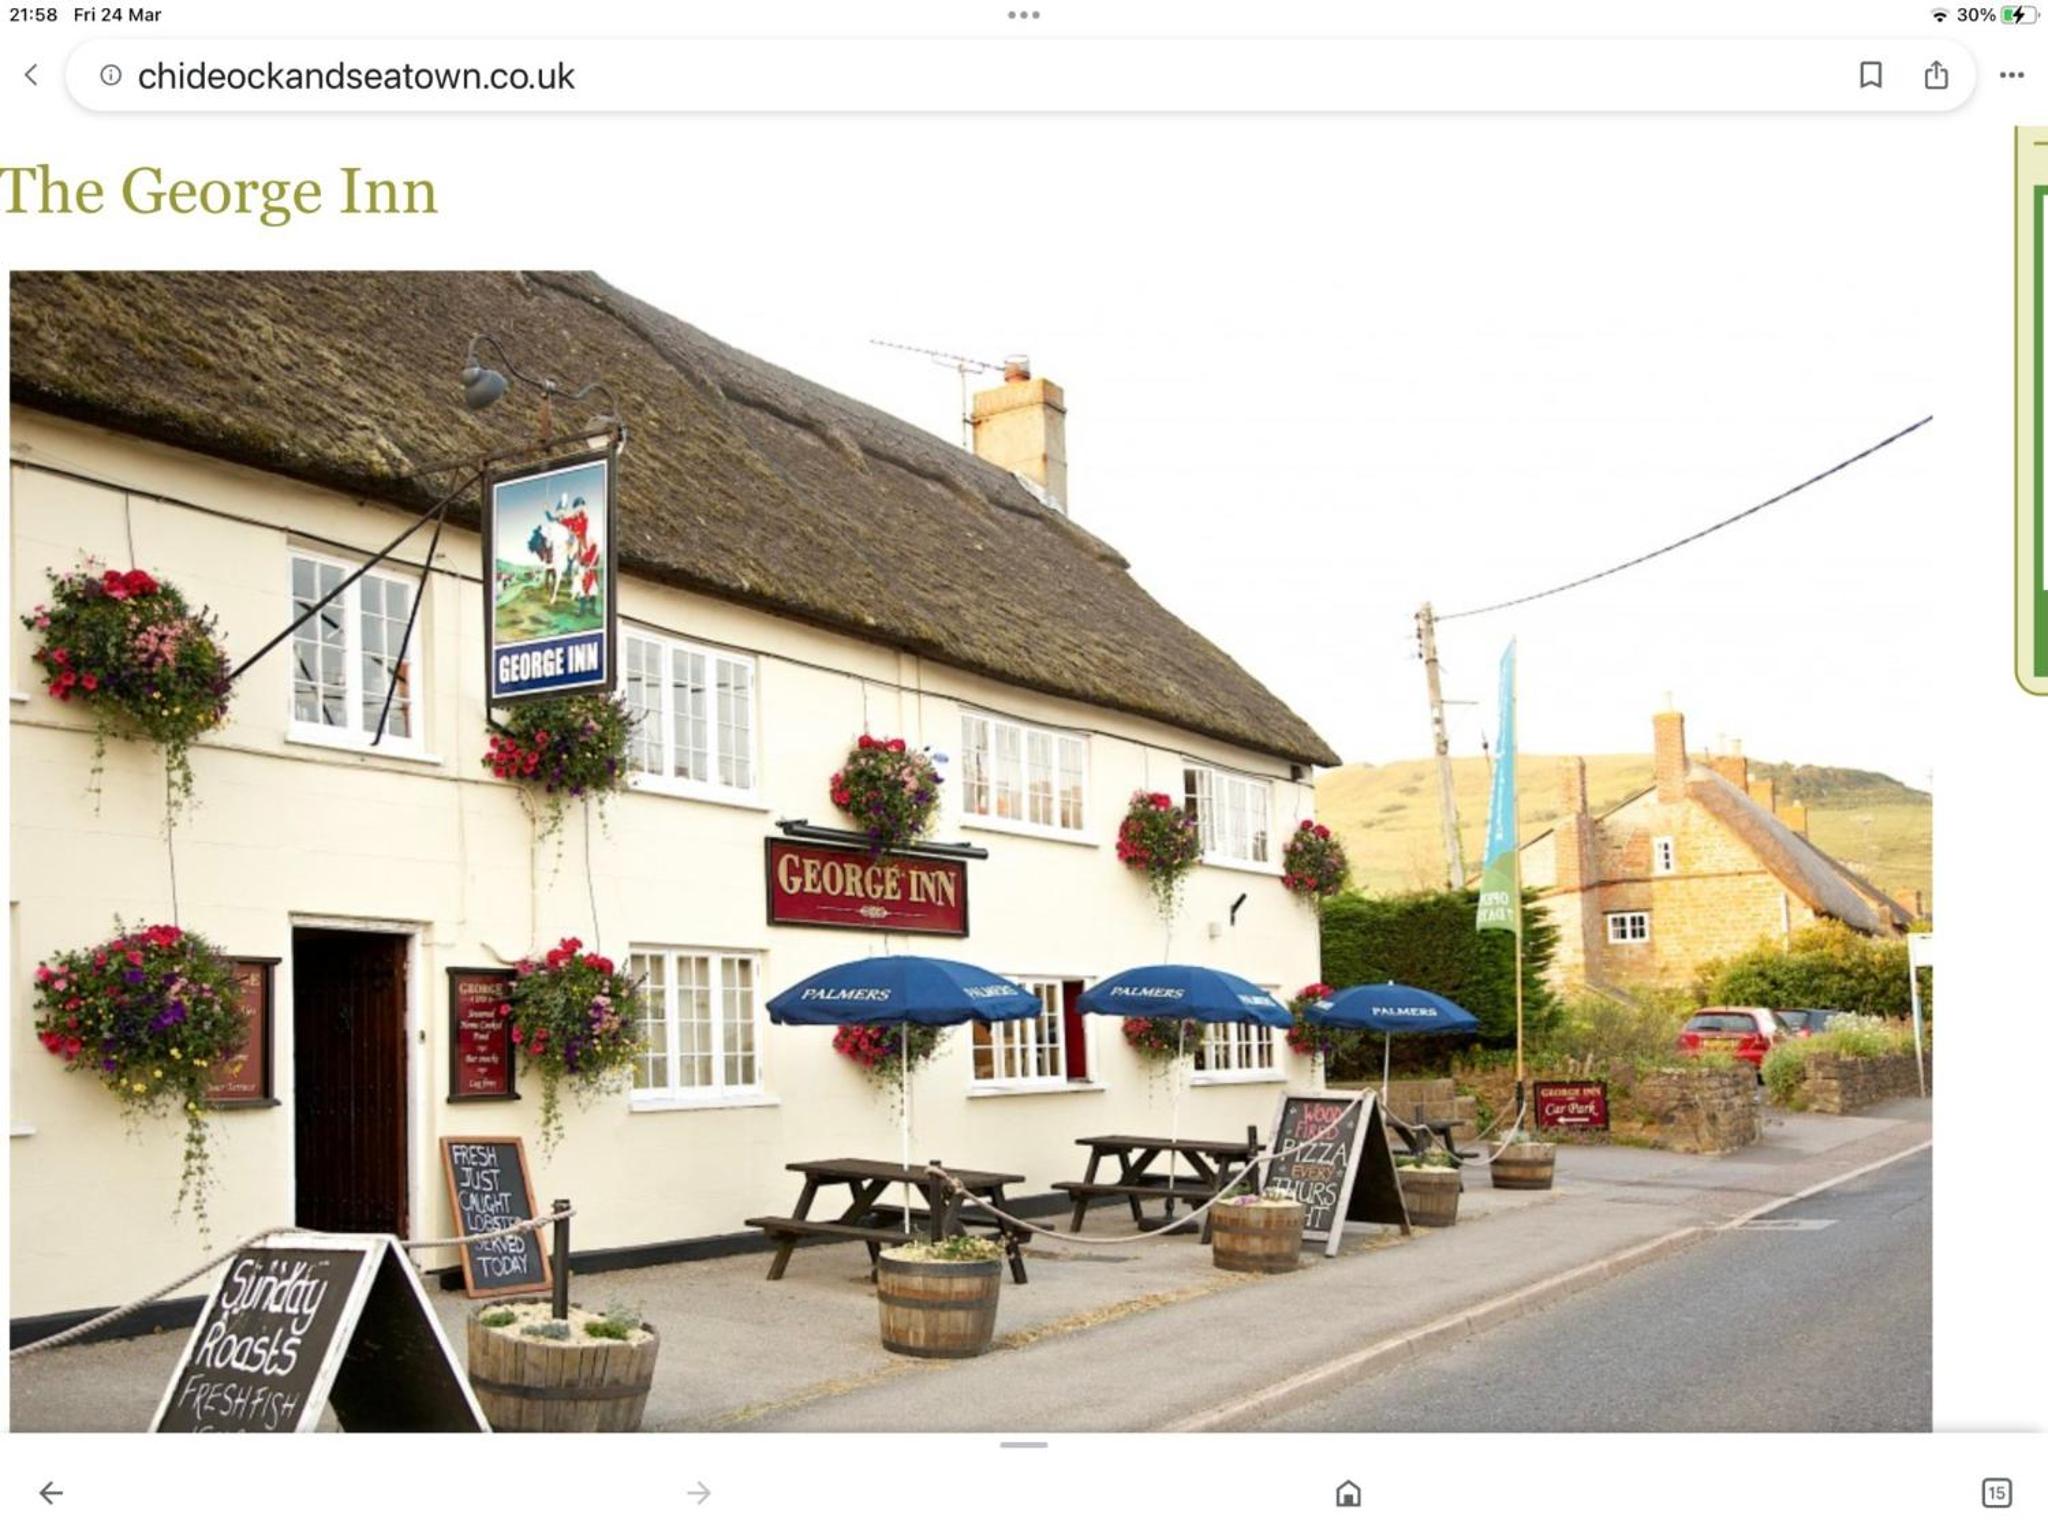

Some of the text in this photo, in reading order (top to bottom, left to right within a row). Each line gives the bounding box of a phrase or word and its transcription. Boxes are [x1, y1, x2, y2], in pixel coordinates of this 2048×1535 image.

[10, 7, 161, 22] 21:58 Fri 24 Mar
[1958, 8, 1996, 22] 30%
[139, 62, 574, 89] chideockandseatown.co.uk
[0, 164, 437, 227] The George Inn
[499, 641, 598, 684] GEORGE INN
[778, 853, 956, 907] GEORGE INN
[802, 987, 891, 1000] PALMERS
[1110, 986, 1185, 1000] PALMERS
[1372, 1005, 1437, 1018] PALMERS
[1545, 1100, 1599, 1116] Car Park
[452, 1144, 499, 1167] FRESH
[1281, 1138, 1348, 1167] PIZZA
[460, 1167, 500, 1192] JUST
[1291, 1165, 1335, 1181] EVERY
[459, 1191, 512, 1215] CAUGHT
[476, 1254, 528, 1278] TODAY
[220, 1259, 328, 1336] Sunday
[195, 1320, 303, 1376] Roasts
[177, 1373, 300, 1431] FRESH FISH
[1990, 1487, 2005, 1499] 15
